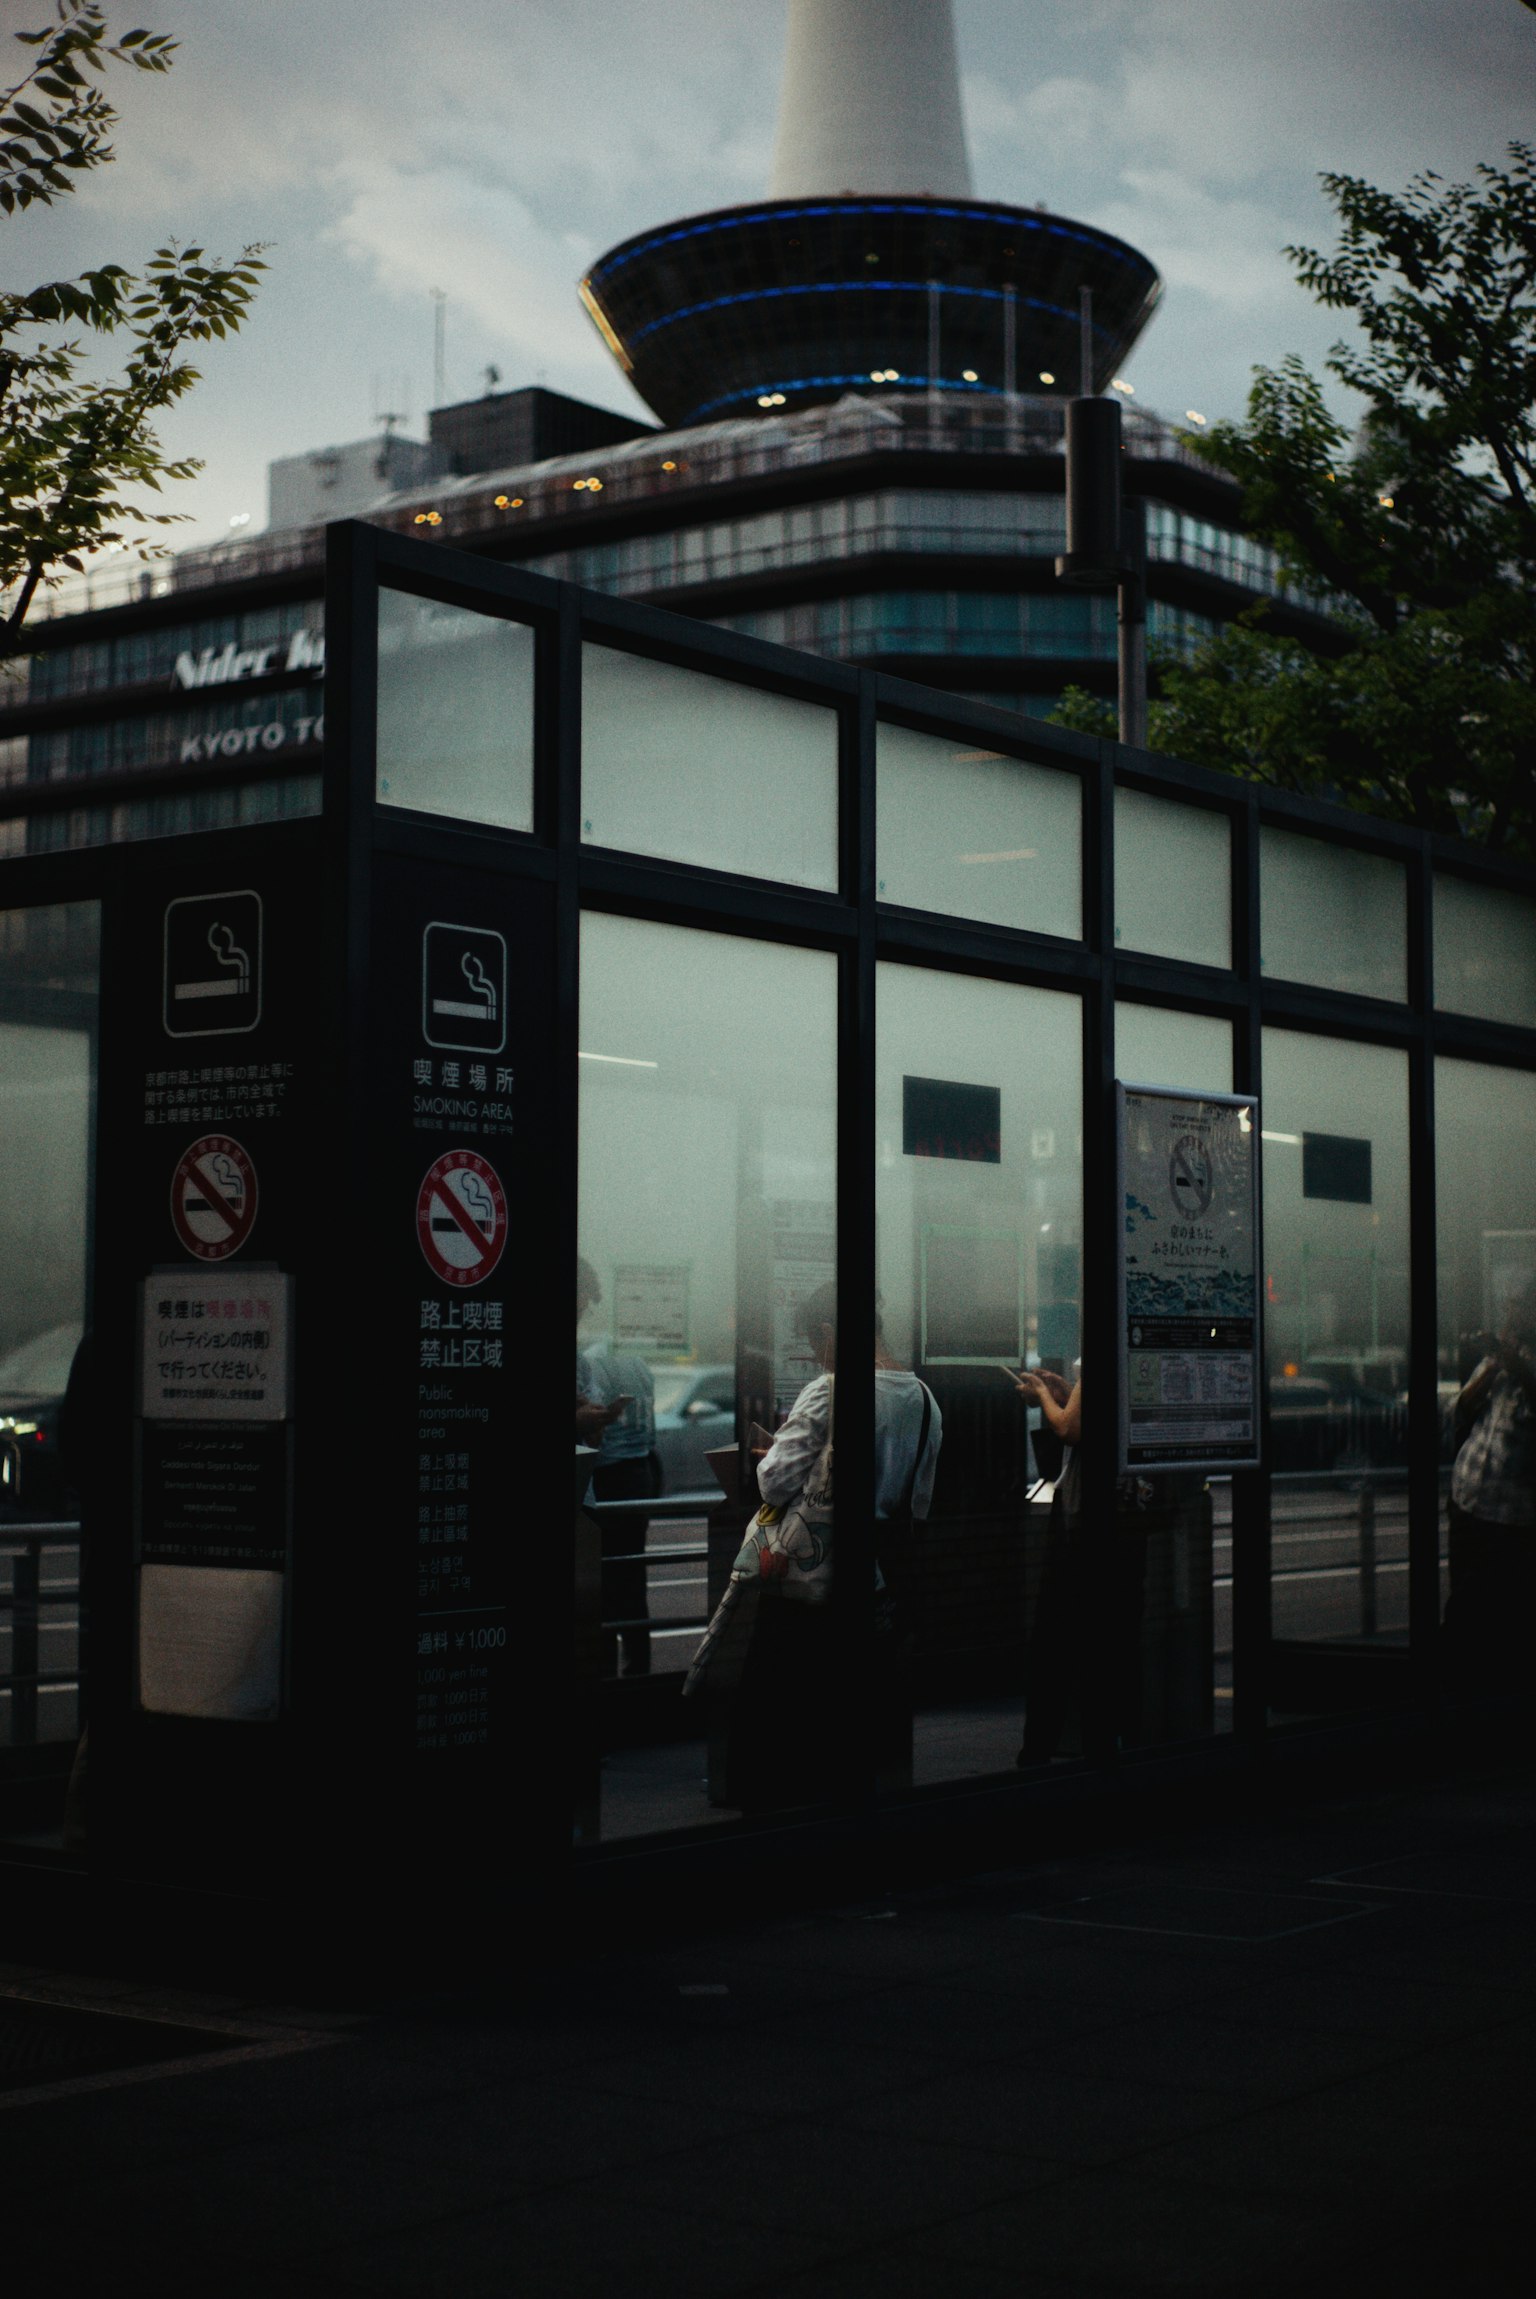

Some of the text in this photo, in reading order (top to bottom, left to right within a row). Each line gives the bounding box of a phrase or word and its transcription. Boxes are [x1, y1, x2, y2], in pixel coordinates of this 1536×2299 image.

[180, 722, 286, 763] KYOTO
[413, 1058, 514, 1095] 喫煙場所
[413, 1095, 514, 1121] SMOKING AREA
[420, 1300, 503, 1330] 路上喫煙
[419, 1338, 503, 1368] 禁止区域
[158, 1360, 267, 1381] で行ってください。
[418, 1384, 453, 1401] Public
[418, 1403, 489, 1422] nonsmoking
[418, 1427, 446, 1439] area
[418, 1474, 470, 1492] 禁止区域
[417, 1632, 449, 1655] 過料
[417, 1663, 488, 1686] 1,000 yen fine
